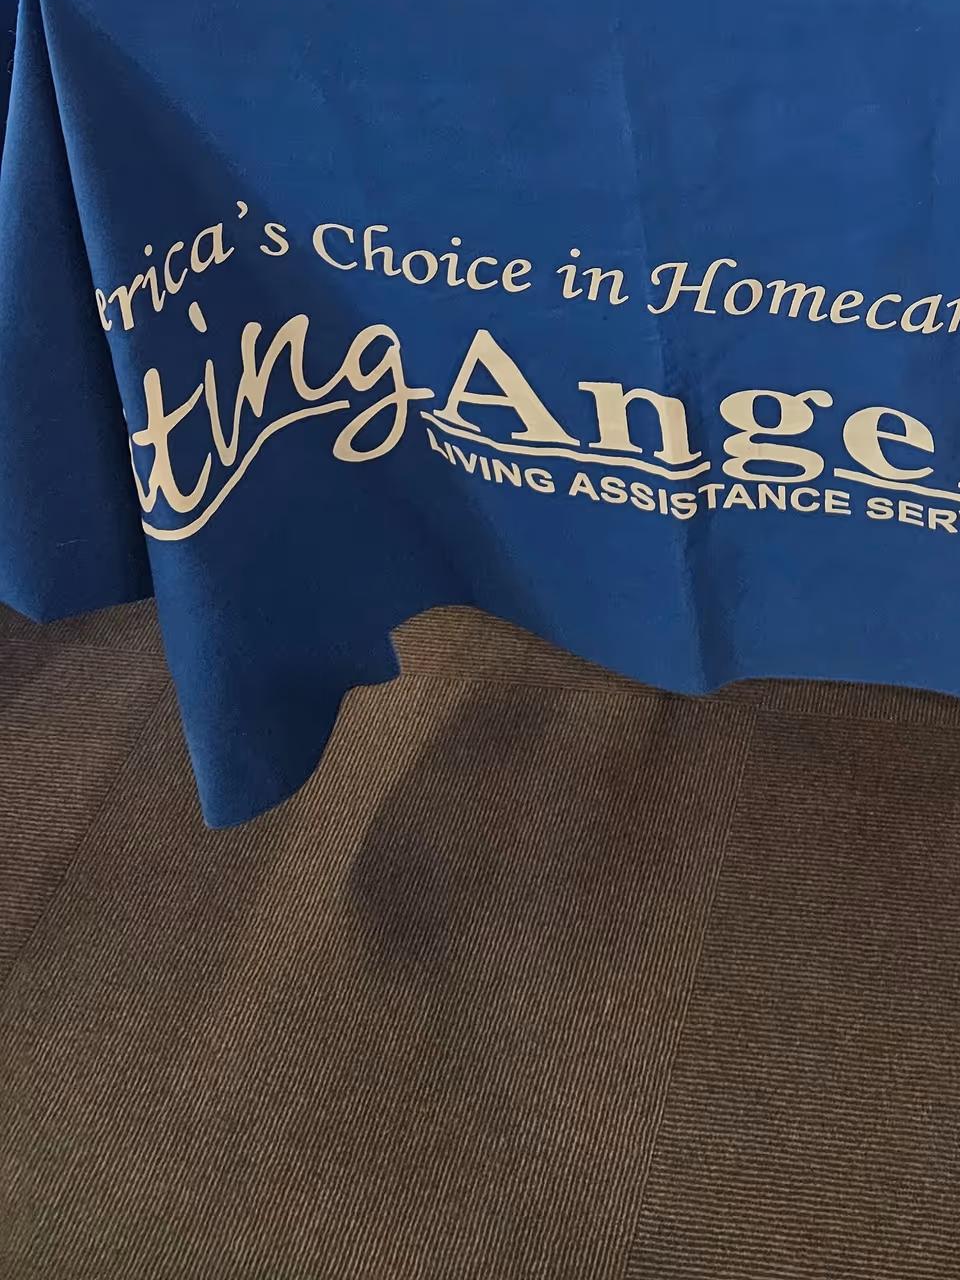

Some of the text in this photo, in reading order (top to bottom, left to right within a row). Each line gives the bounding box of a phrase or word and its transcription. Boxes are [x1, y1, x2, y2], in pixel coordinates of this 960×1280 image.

[312, 222, 533, 293] Choice
[556, 248, 629, 305] in
[426, 427, 556, 493] LIVING
[568, 472, 852, 520] ASSISTANCE
